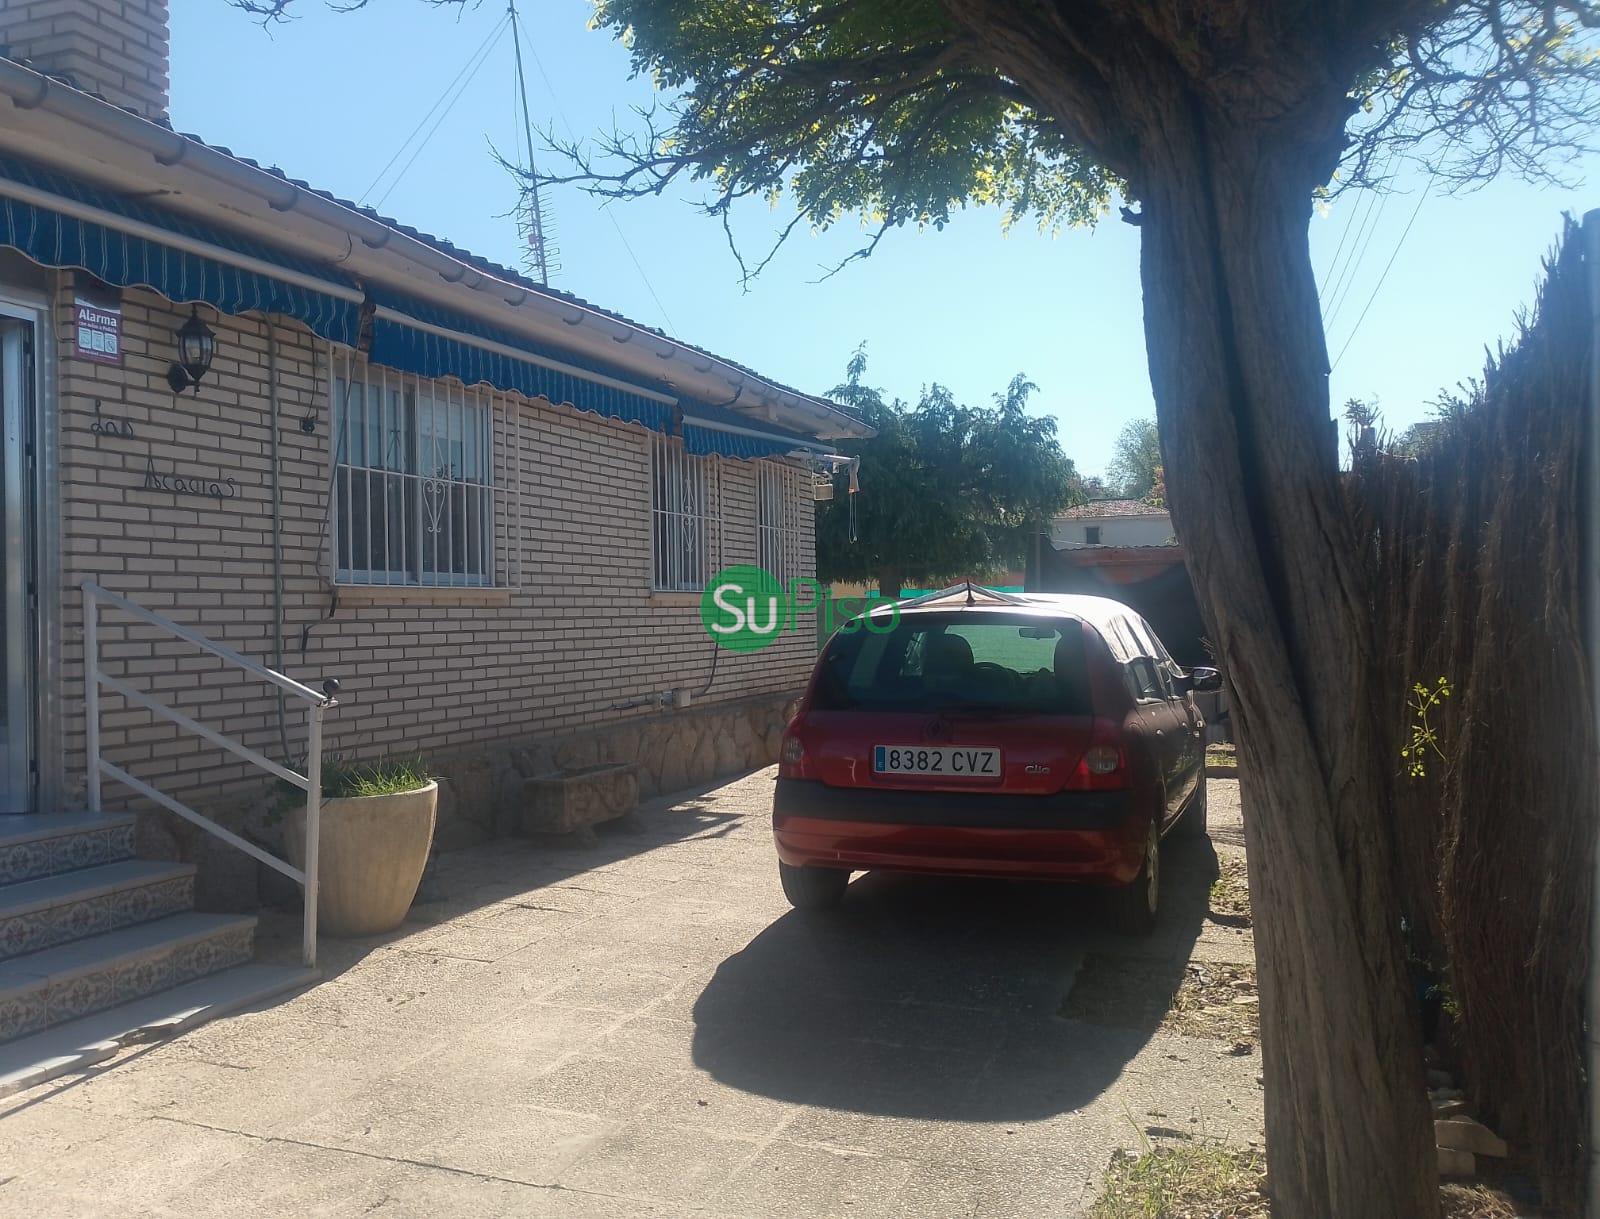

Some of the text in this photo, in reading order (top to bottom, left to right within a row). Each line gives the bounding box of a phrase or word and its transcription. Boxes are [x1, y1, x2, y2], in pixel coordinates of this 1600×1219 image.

[79, 309, 117, 326] Alarma
[889, 749, 943, 772] 8382
[951, 751, 994, 773] CVZ
